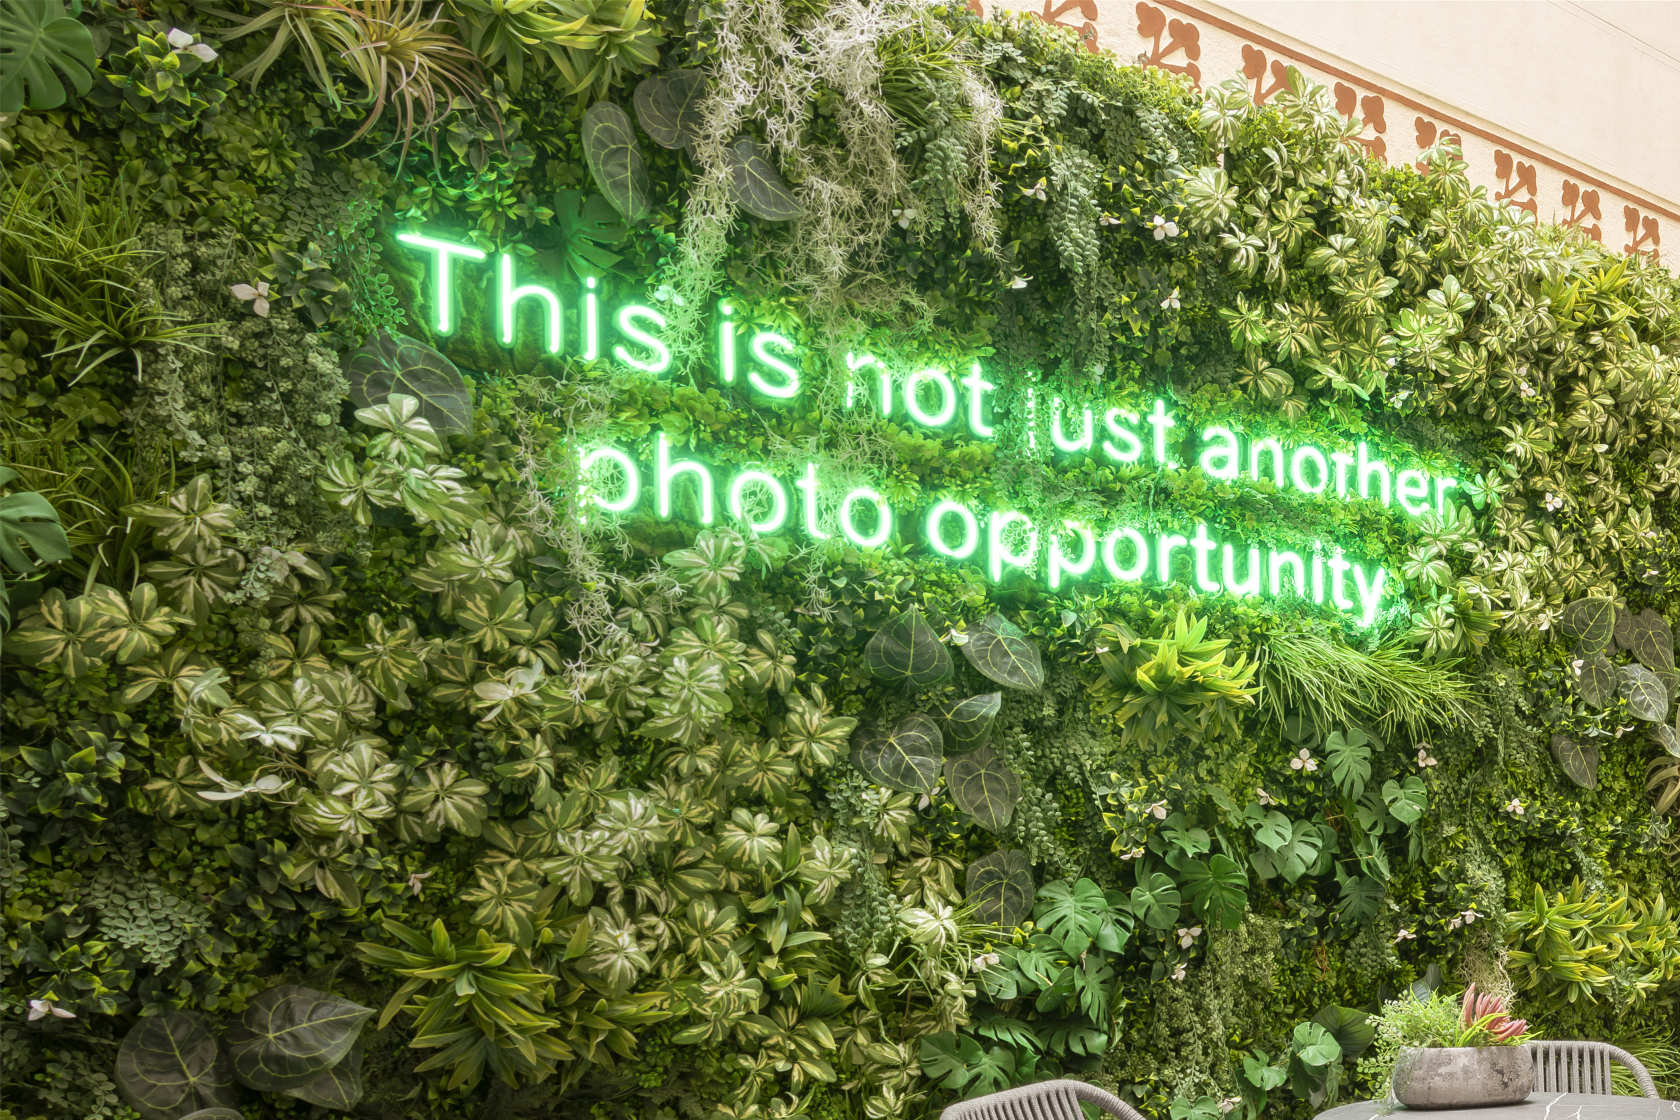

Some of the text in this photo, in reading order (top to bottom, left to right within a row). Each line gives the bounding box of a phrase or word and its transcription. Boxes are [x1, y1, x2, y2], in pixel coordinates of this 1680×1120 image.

[395, 232, 672, 374] This
[719, 299, 800, 399] is
[846, 350, 995, 438] not
[1200, 424, 1458, 517] another
[577, 430, 1386, 628] photo opportunity
